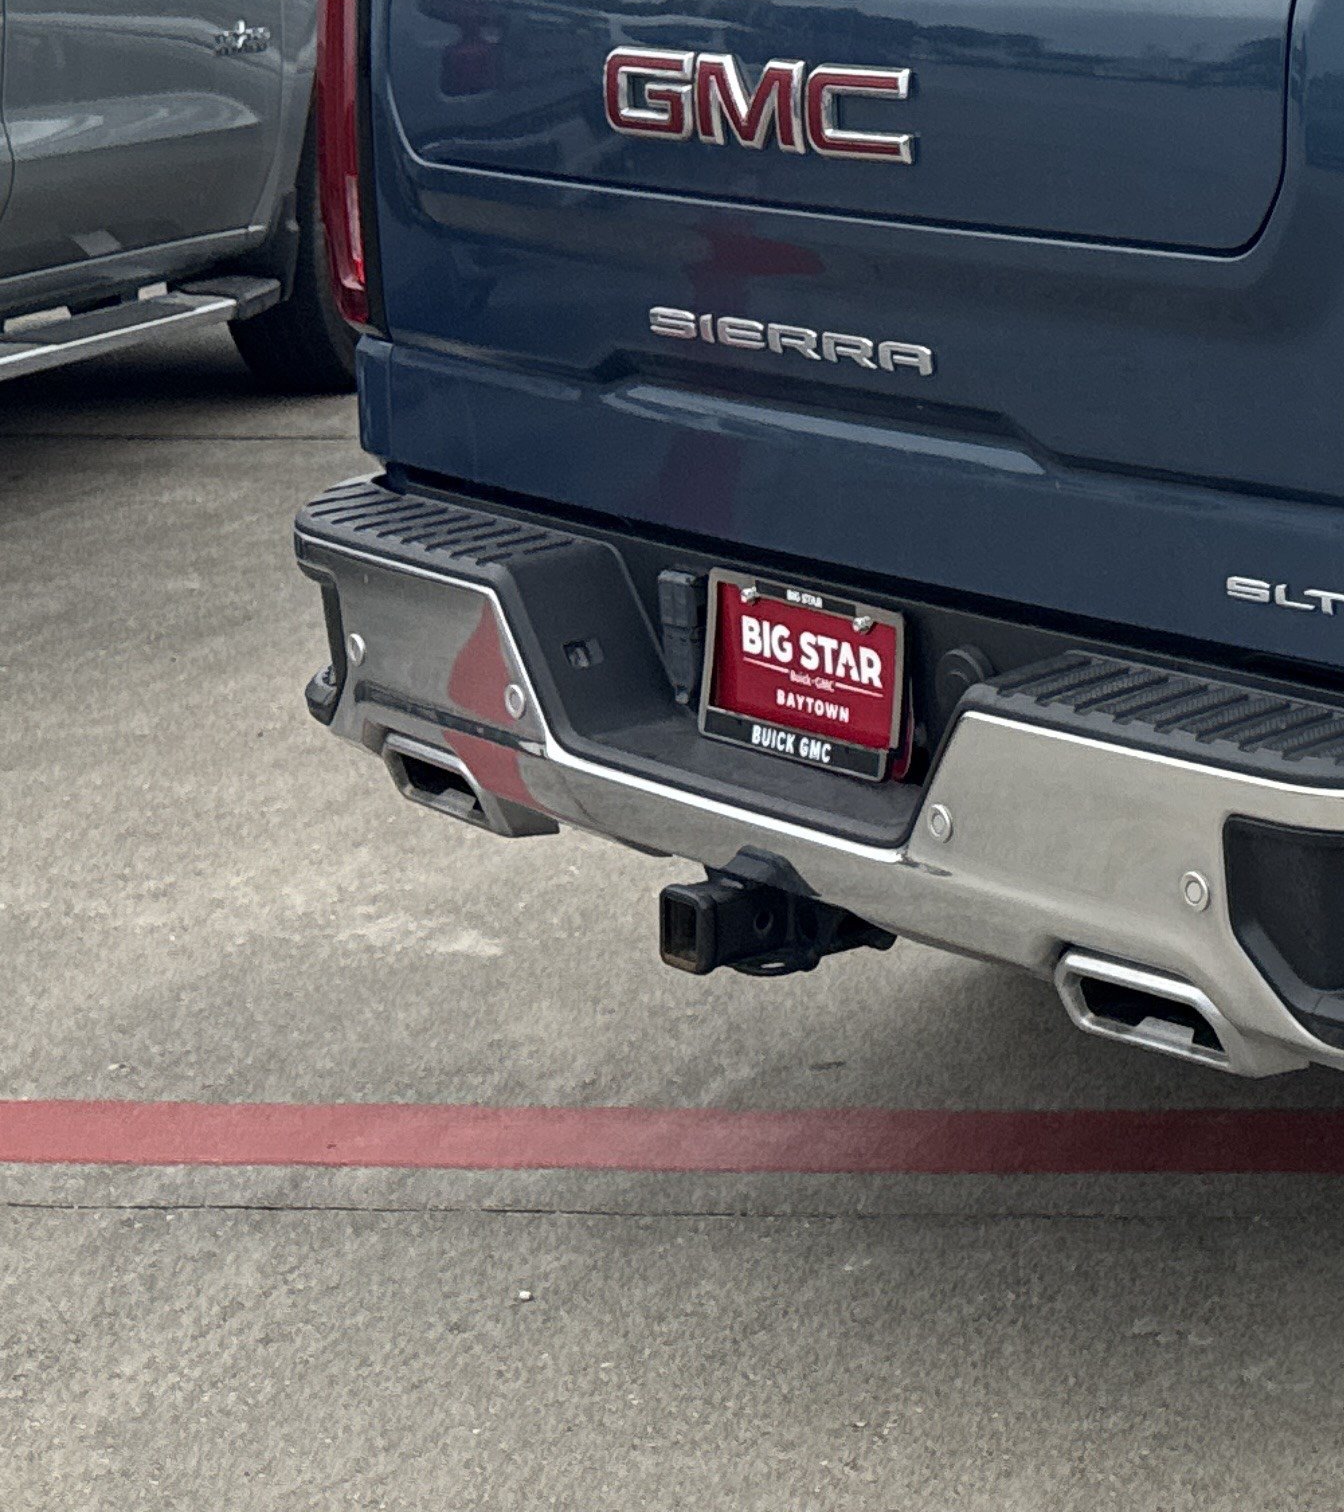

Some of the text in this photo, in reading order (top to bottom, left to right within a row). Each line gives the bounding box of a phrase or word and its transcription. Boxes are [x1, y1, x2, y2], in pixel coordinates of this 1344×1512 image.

[603, 46, 912, 164] GMC
[649, 306, 933, 375] SIERRA
[786, 589, 823, 608] BIG STAR
[741, 615, 883, 688] BIG STAR
[776, 689, 850, 723] BAYTOWN
[752, 724, 832, 763] BUICK GMC
